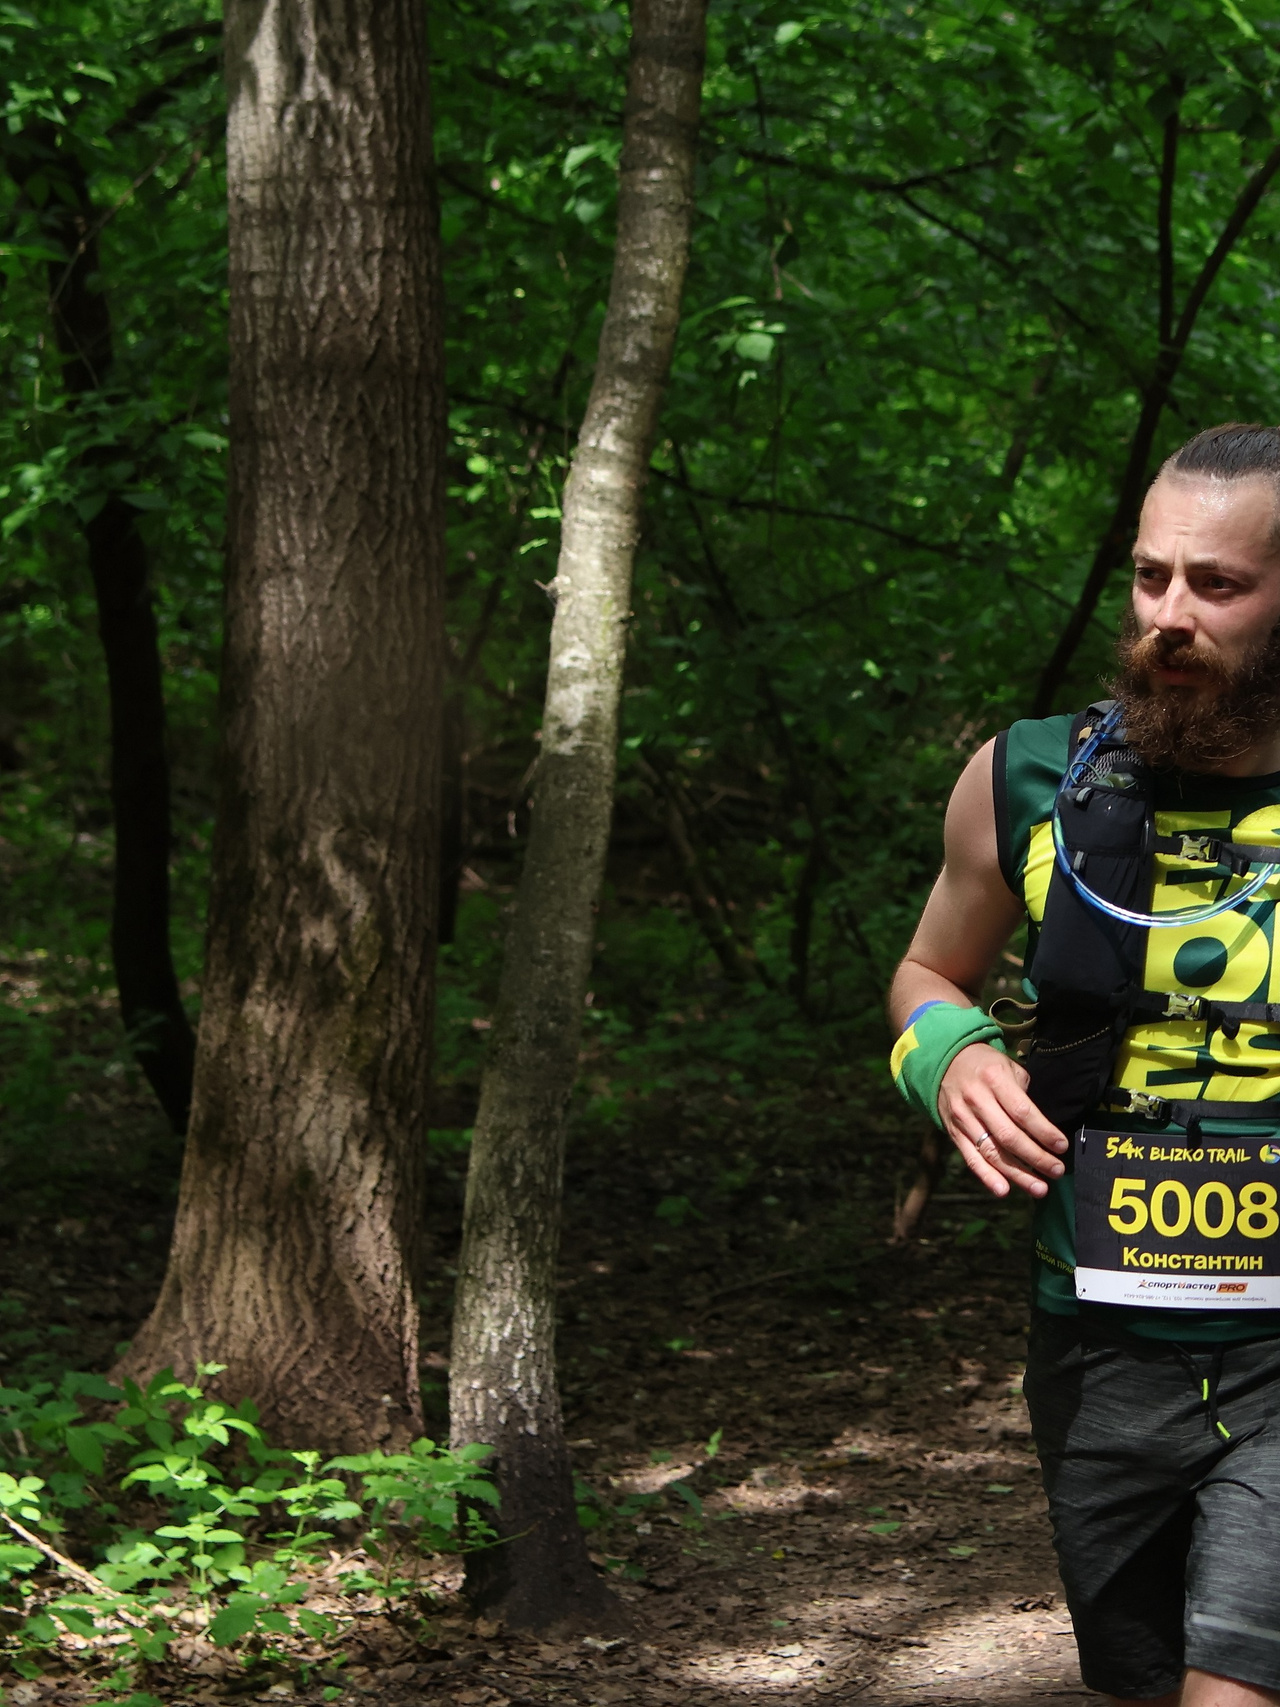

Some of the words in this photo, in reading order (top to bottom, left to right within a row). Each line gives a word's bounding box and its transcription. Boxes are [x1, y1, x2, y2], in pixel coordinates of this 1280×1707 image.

[1150, 1146, 1204, 1163] BLIZKO
[1207, 1148, 1252, 1164] TRAIL
[1107, 1177, 1280, 1239] 5008
[1122, 1247, 1264, 1271] Константин
[1218, 1284, 1246, 1292] PRO
